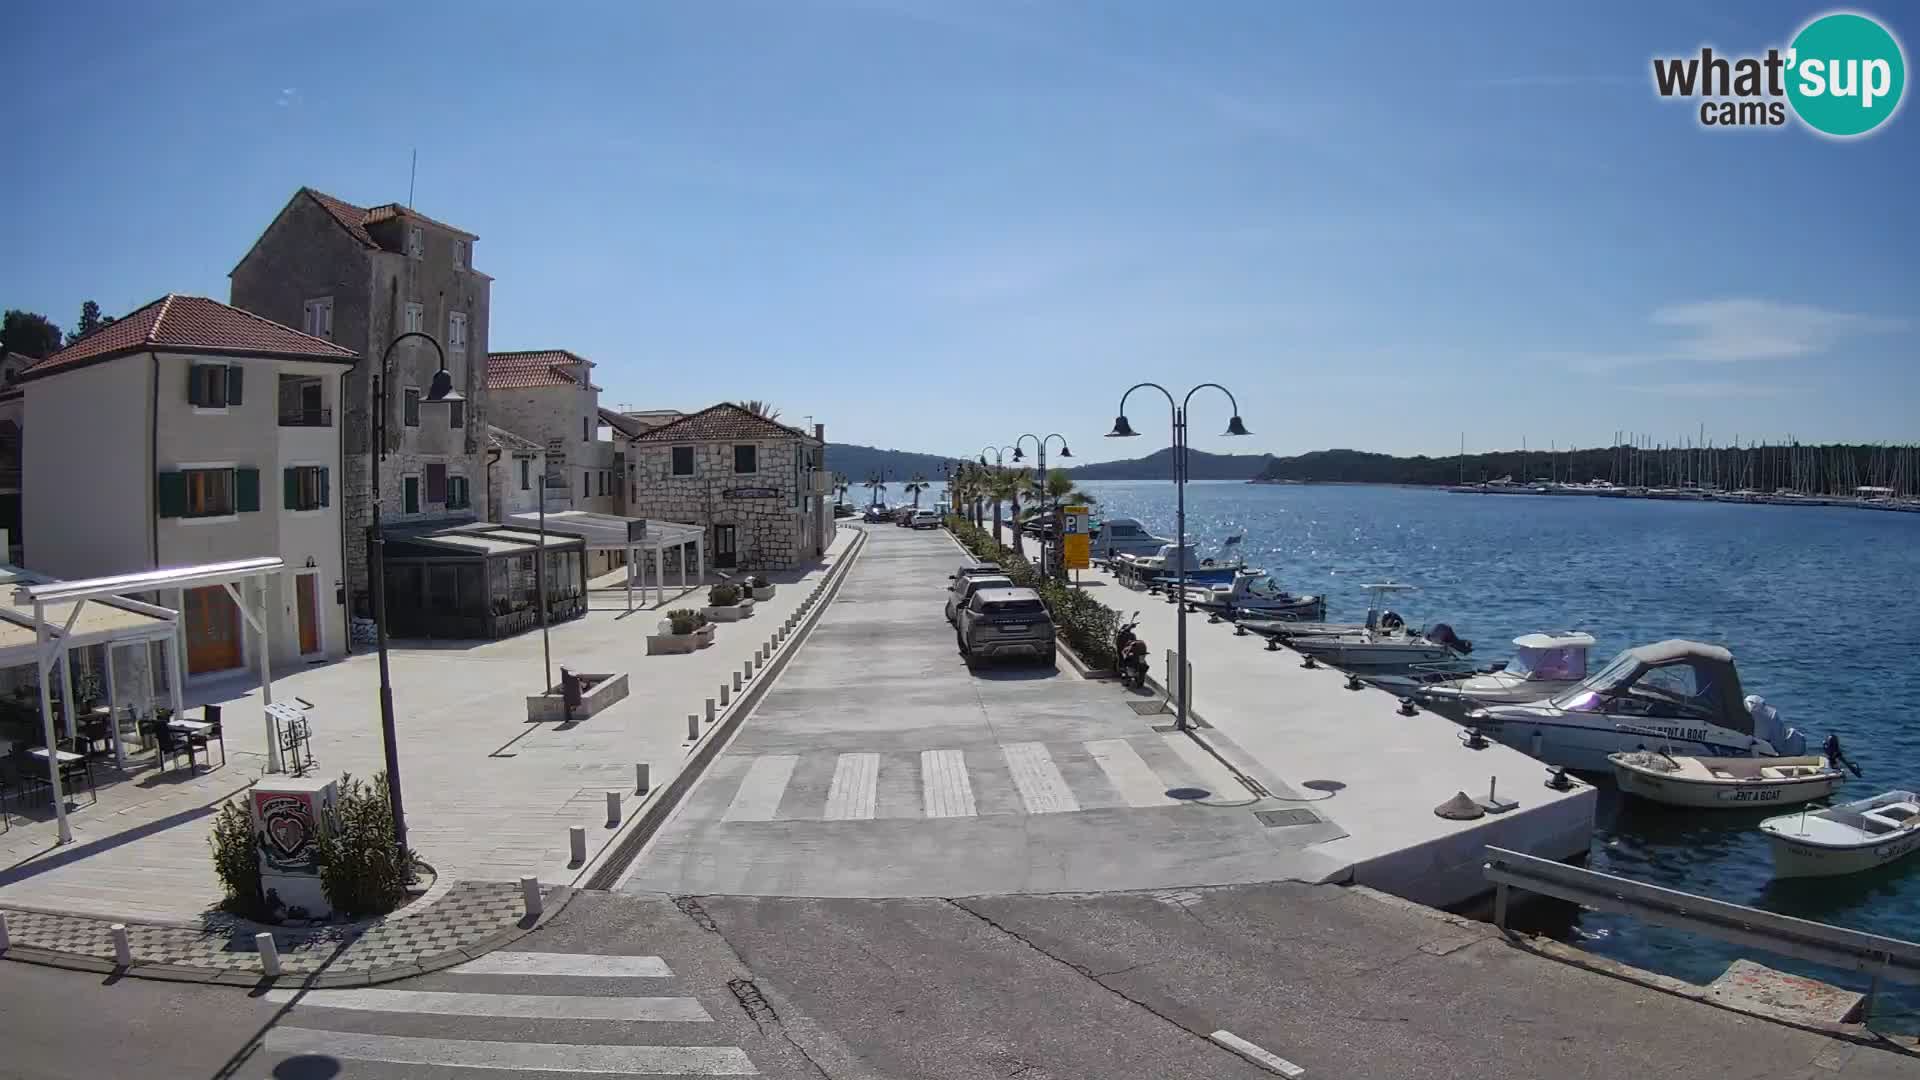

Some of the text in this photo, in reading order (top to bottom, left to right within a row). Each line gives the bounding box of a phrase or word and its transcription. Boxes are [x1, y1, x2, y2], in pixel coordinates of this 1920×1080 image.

[1066, 516, 1076, 528] P
[1680, 727, 1686, 737] A
[1687, 728, 1708, 741] BOAT
[1760, 790, 1781, 801] BOAT
